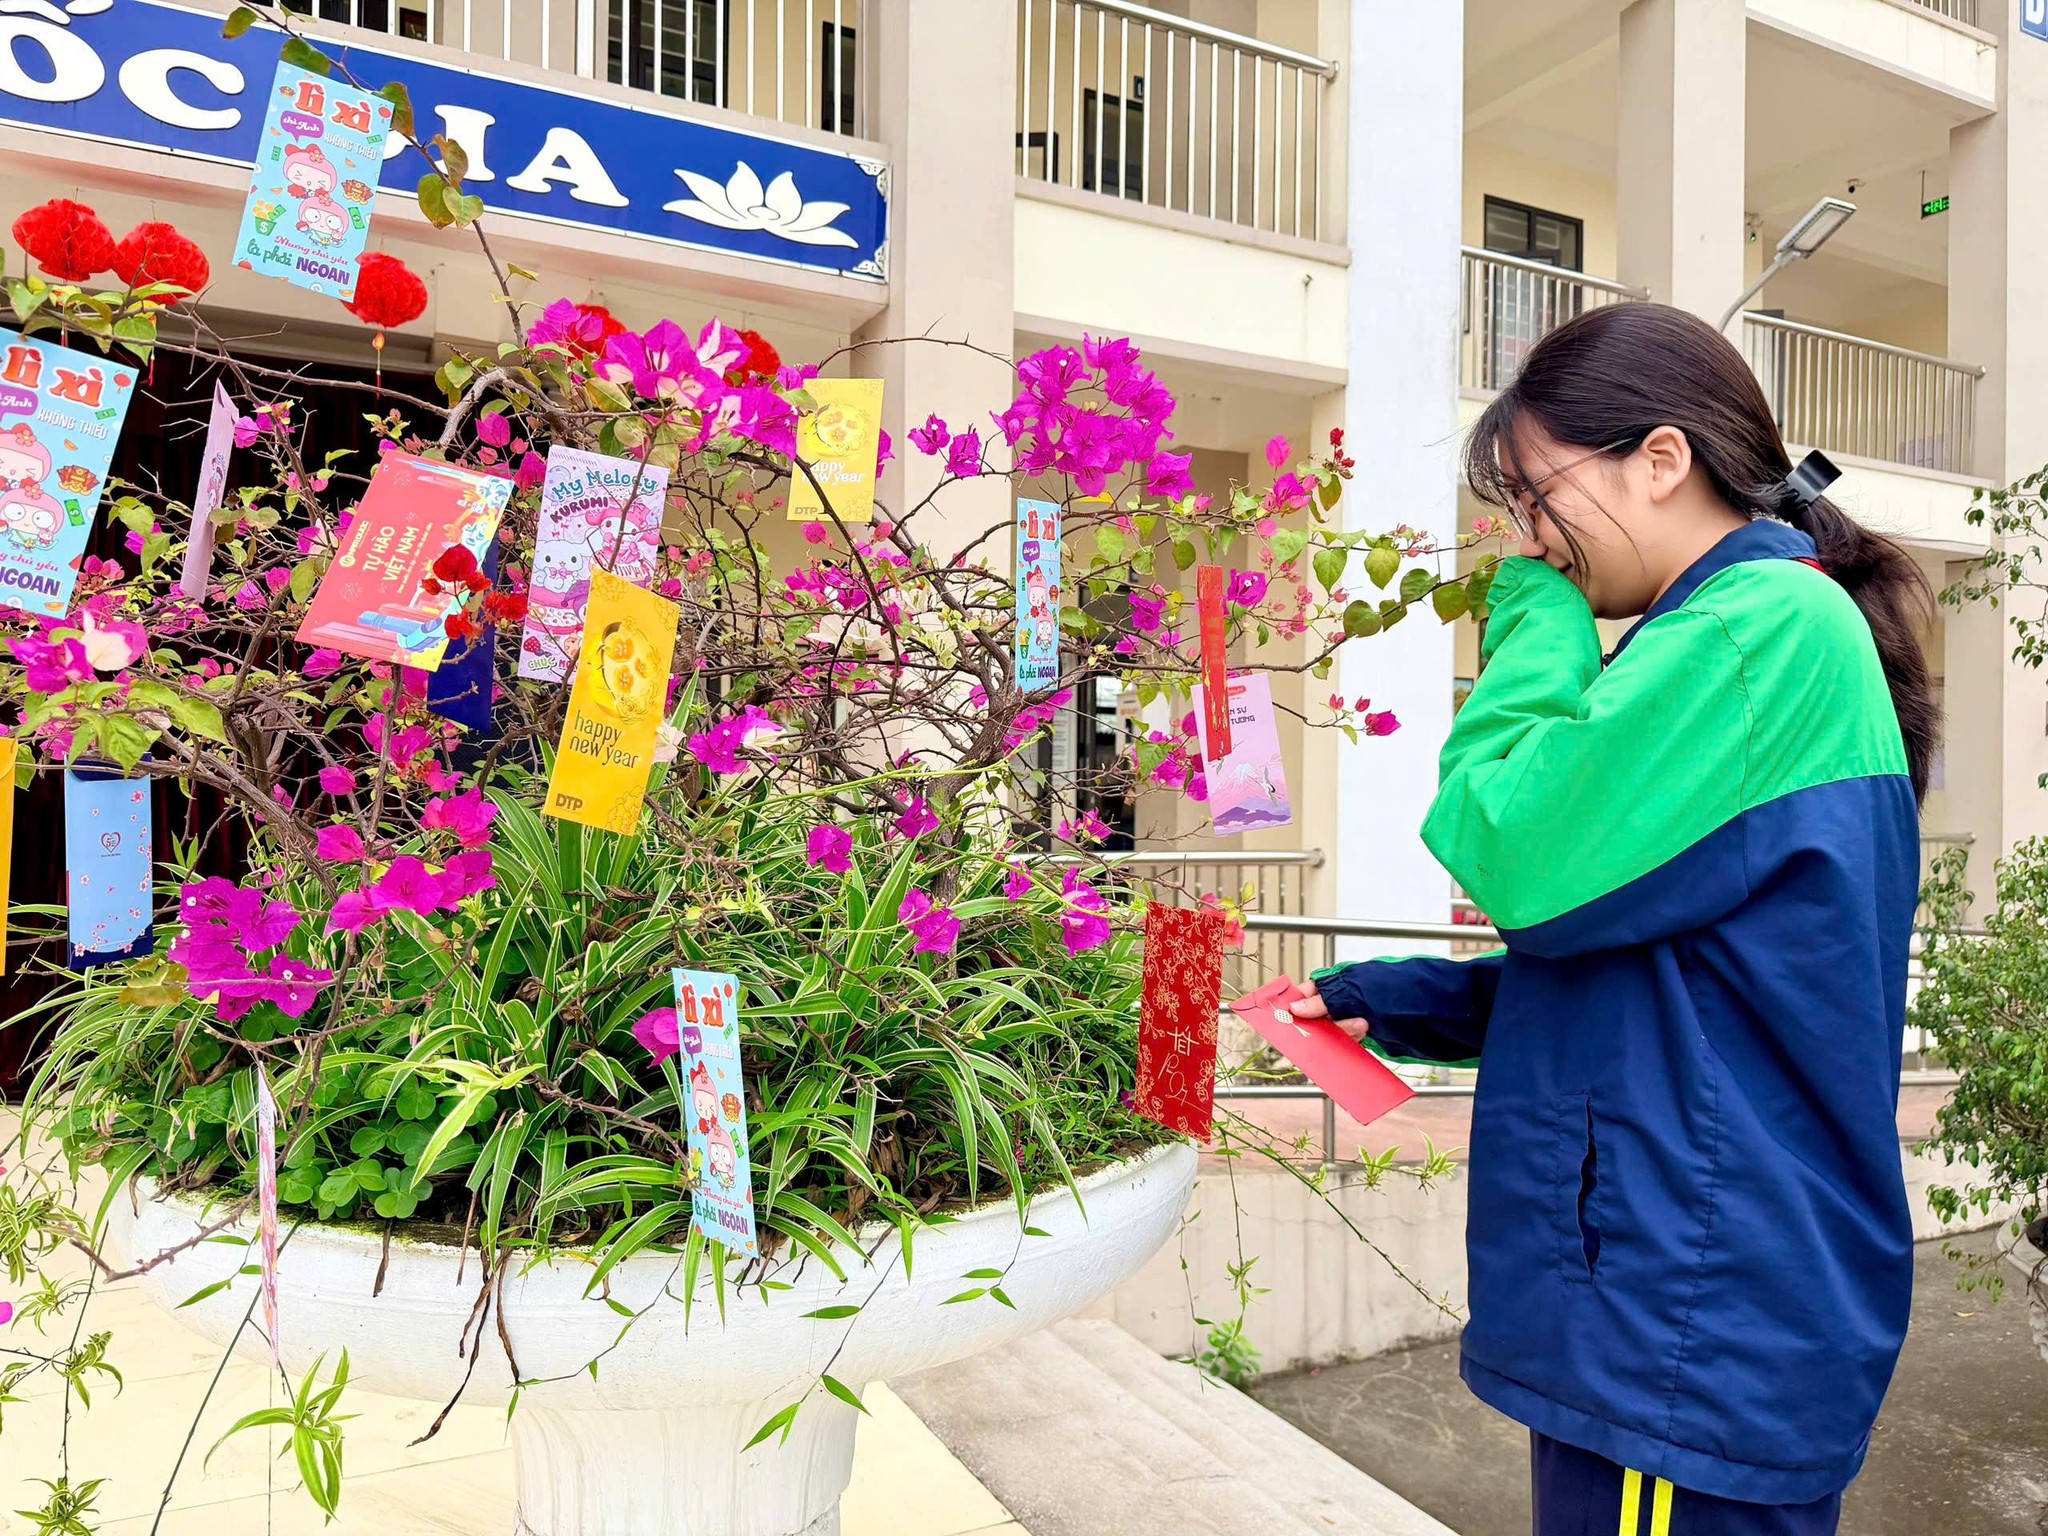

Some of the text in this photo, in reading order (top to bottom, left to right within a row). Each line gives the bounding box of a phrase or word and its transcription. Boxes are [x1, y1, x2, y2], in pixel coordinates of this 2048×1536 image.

[382, 104, 630, 207] IA
[295, 257, 350, 285] NGOAN
[551, 478, 584, 501] My
[832, 472, 865, 486] year
[549, 496, 609, 523] KURUMI
[794, 506, 819, 515] DTP
[371, 525, 396, 554] HÀO
[395, 525, 420, 554] NAM
[574, 709, 623, 748] happy
[569, 735, 639, 768] new year
[555, 793, 583, 811] DTP
[718, 1208, 749, 1236] NGOAN
